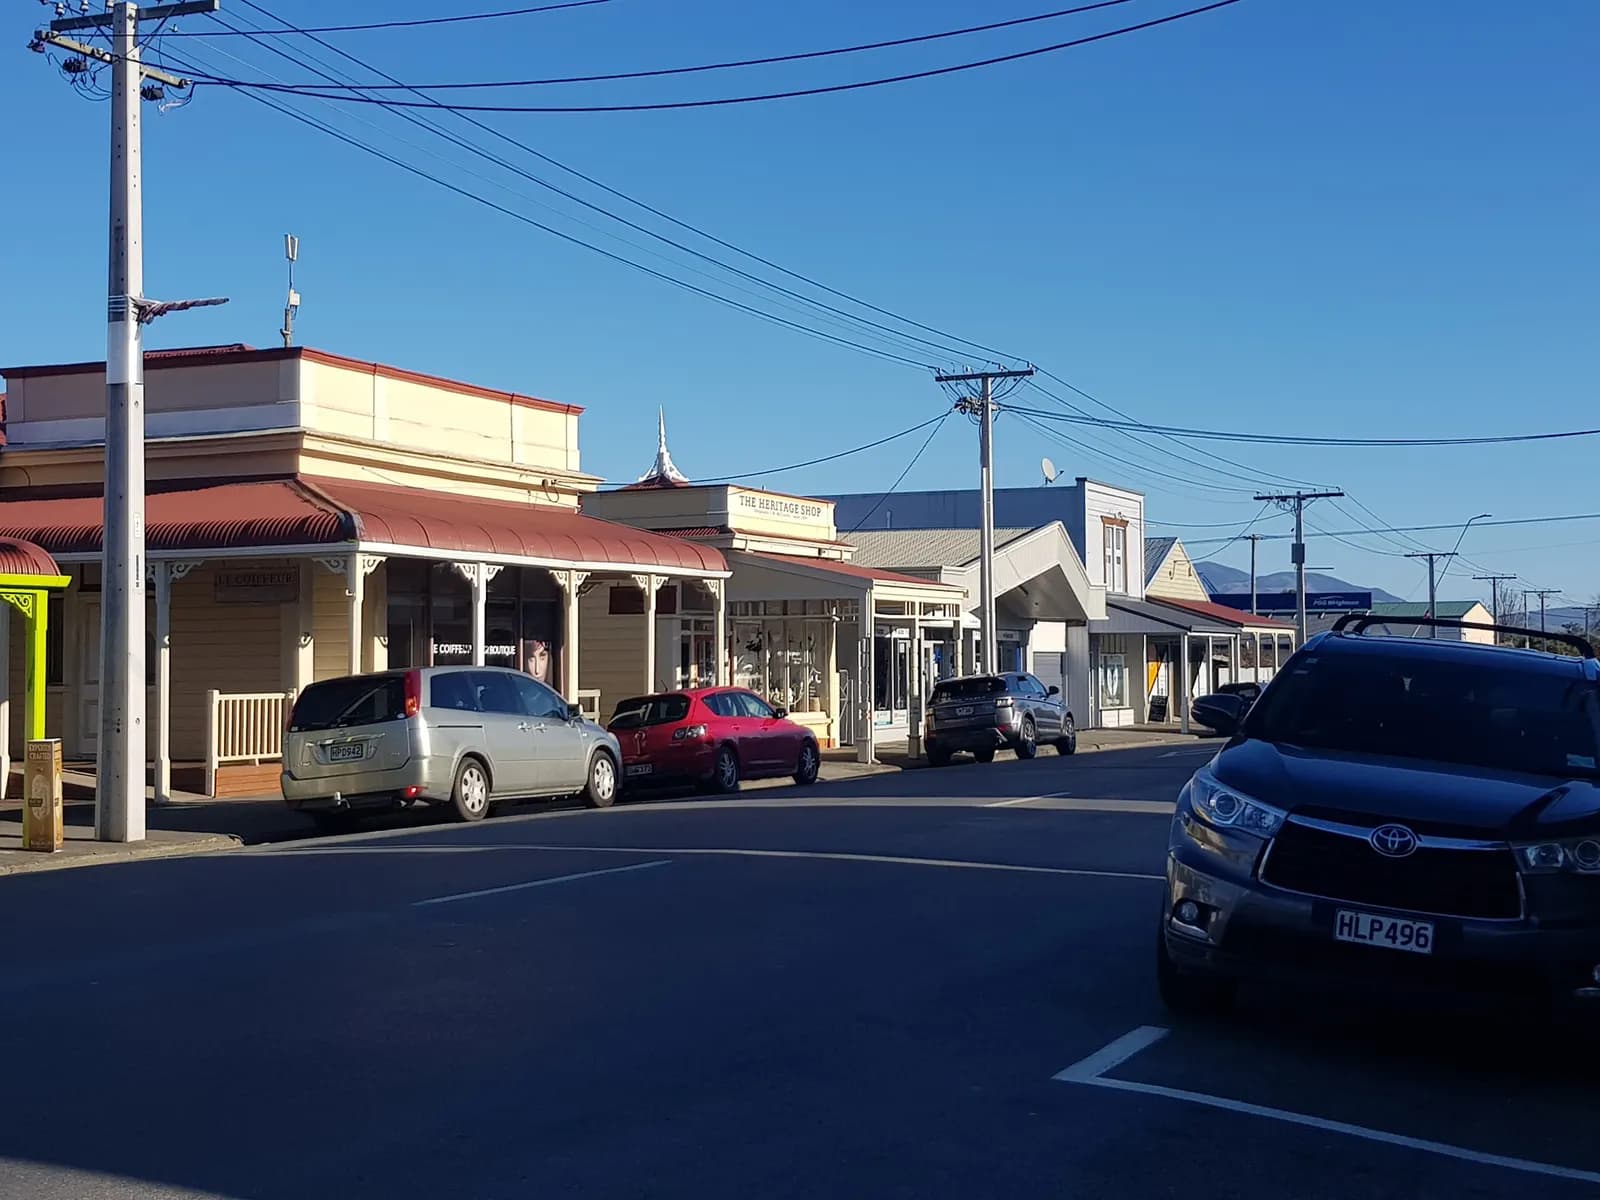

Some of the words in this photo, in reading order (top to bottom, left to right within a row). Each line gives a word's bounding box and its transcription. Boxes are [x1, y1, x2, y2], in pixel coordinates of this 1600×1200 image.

[739, 495, 757, 508] THE
[758, 497, 799, 515] HERITAGE
[800, 504, 822, 517] SHOP
[1338, 914, 1430, 949] HLP496
